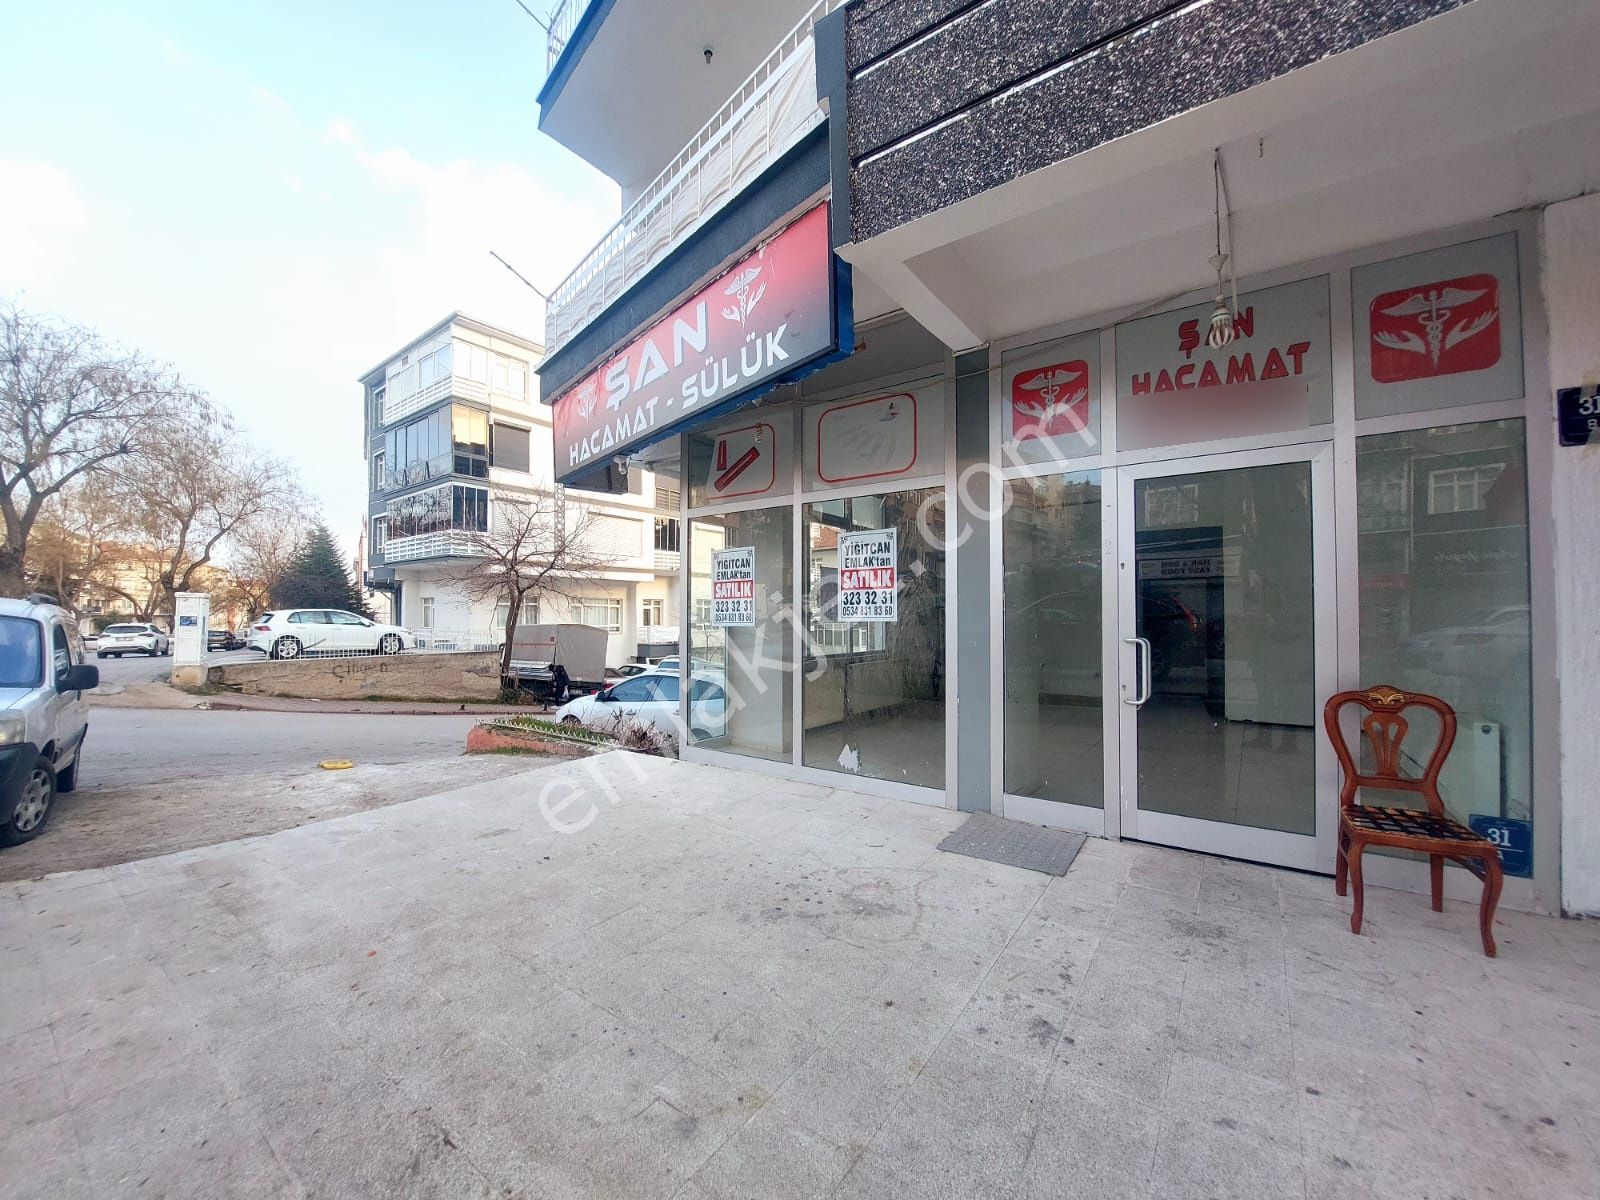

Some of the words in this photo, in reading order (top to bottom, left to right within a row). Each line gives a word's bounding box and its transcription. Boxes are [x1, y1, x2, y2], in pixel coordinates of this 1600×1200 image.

[1178, 306, 1254, 360] ŞN
[605, 301, 707, 412] ŞAN
[1131, 341, 1311, 396] HACAMAT
[568, 396, 664, 467] HACAMAT
[682, 322, 790, 410] SÜLÜK
[844, 556, 891, 568] EMLAK'tan
[843, 569, 892, 589] SATILIK
[715, 581, 752, 598] SATILIK
[842, 592, 861, 605] 323
[864, 591, 877, 605] 32
[881, 590, 893, 604] 31
[715, 601, 729, 613] 323
[731, 600, 741, 612] 32
[1487, 828, 1512, 847] 31
